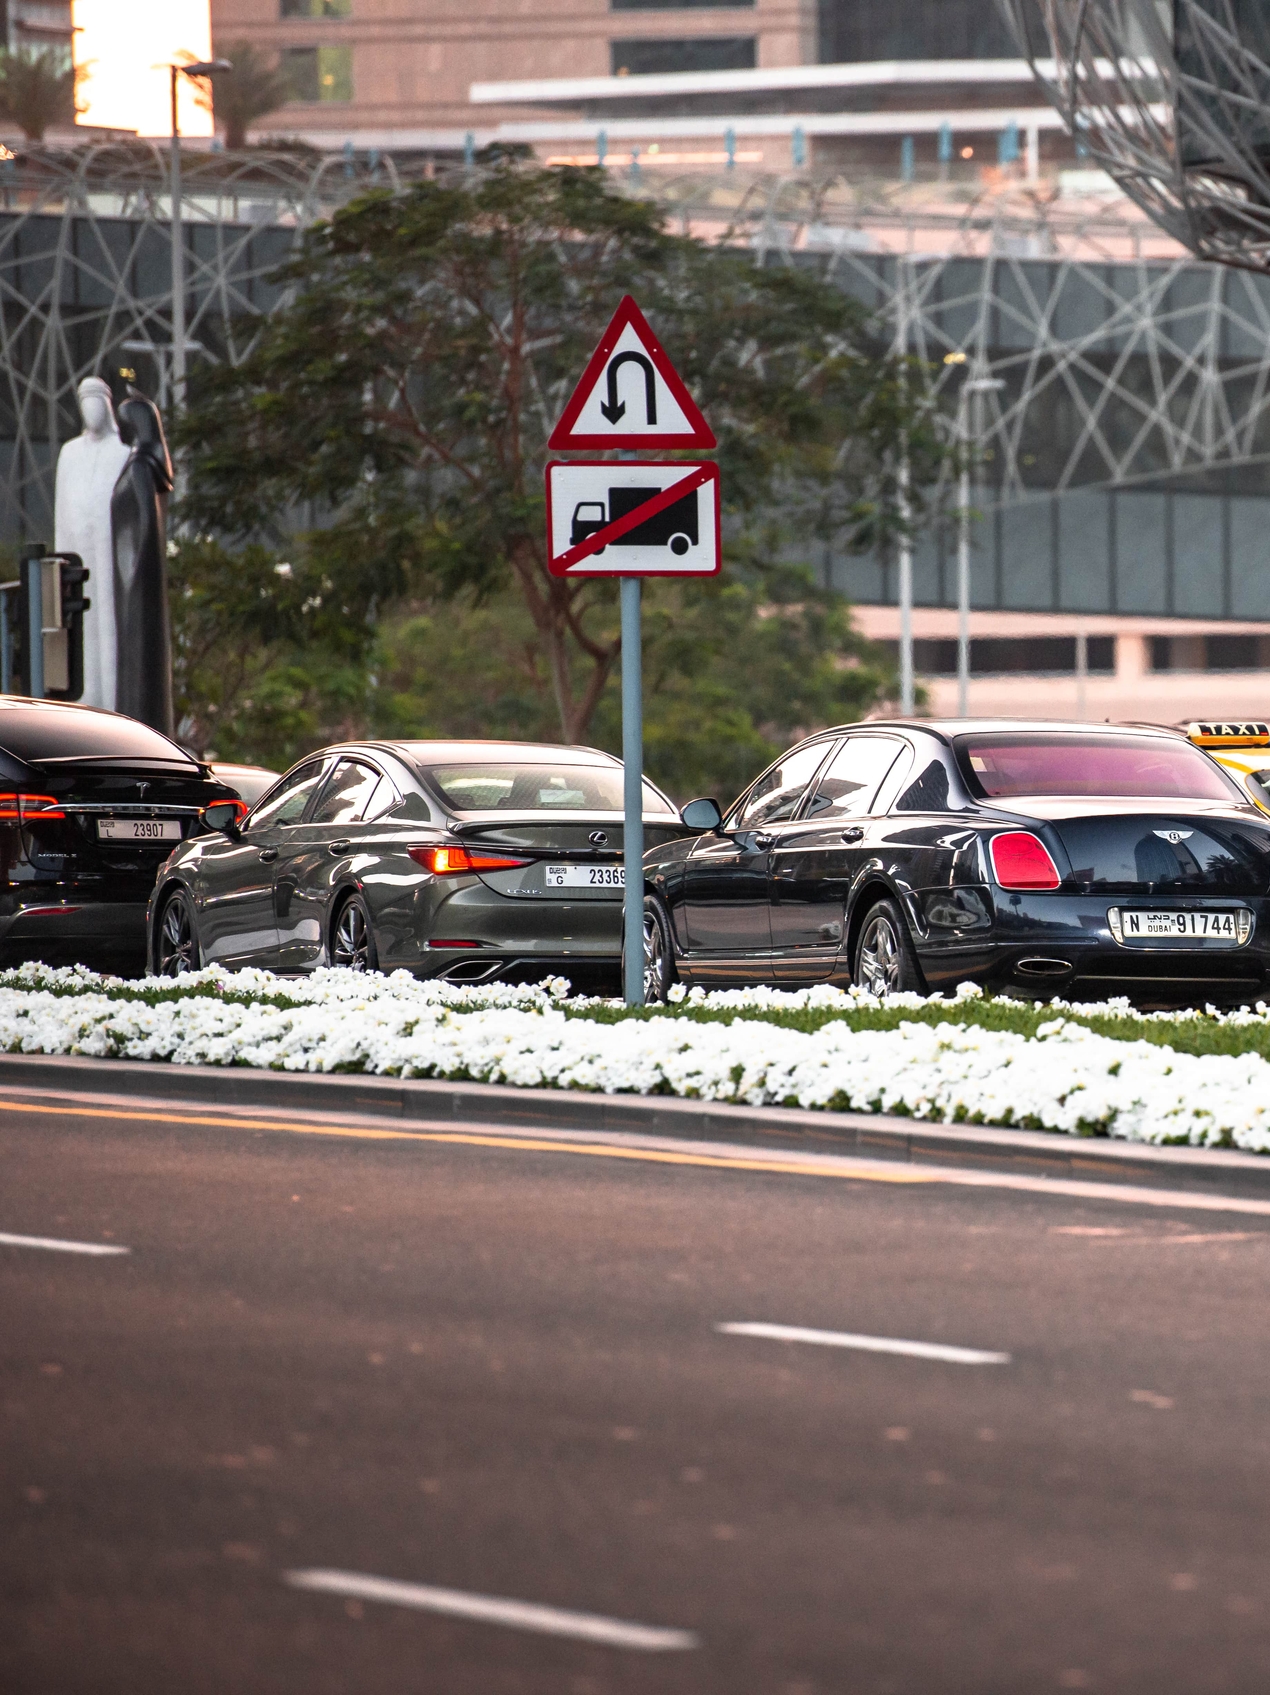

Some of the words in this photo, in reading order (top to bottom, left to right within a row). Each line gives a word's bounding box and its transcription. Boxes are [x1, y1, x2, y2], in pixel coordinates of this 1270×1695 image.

[1206, 724, 1260, 735] TAXI
[106, 829, 113, 837] L
[133, 823, 164, 837] 23907
[556, 875, 564, 885] G
[1130, 914, 1140, 933] N
[1176, 914, 1233, 935] 91744
[1148, 925, 1172, 933] DUBAI
